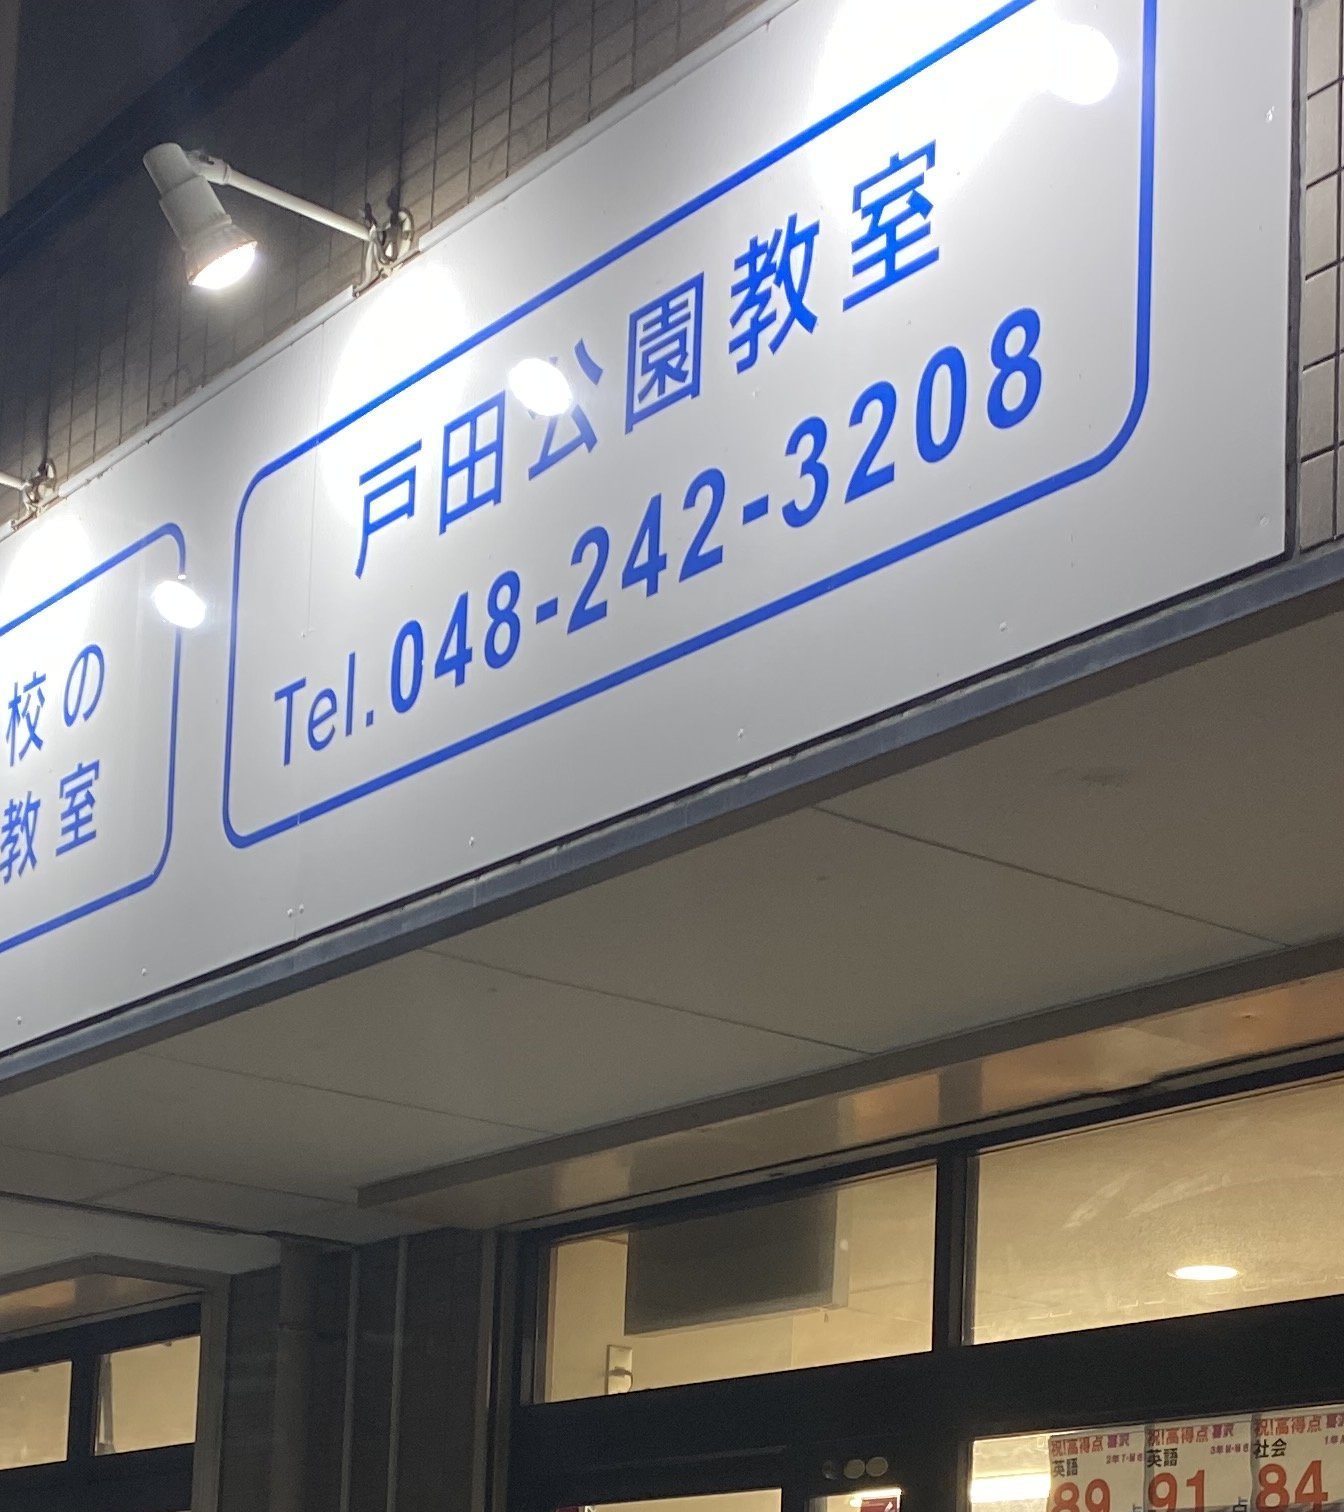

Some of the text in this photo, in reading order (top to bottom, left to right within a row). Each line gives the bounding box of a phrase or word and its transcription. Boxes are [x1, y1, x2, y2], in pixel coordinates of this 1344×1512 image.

[352, 138, 940, 579] 戸田公園教室
[1147, 1448, 1178, 1468] 英語
[1255, 1438, 1287, 1458] 社会
[1053, 1458, 1078, 1478] 英語
